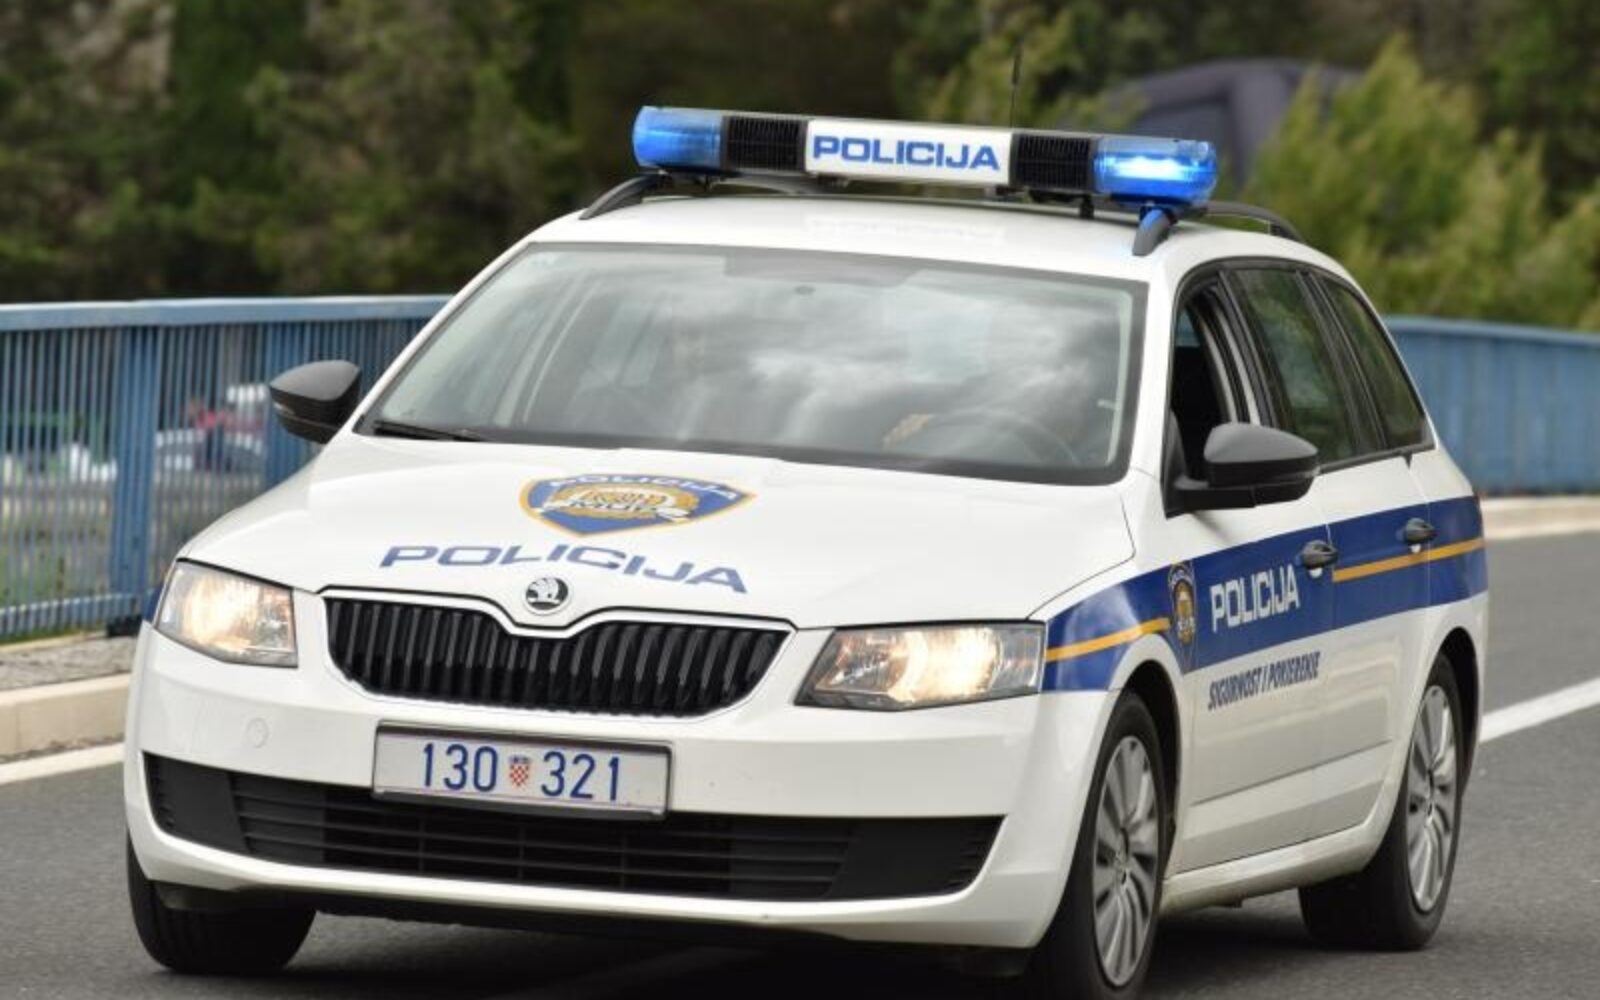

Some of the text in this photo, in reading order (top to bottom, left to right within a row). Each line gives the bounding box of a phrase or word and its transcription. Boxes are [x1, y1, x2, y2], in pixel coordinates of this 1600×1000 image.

[813, 135, 1000, 170] POLICIJA
[550, 475, 737, 500] POLICIJA
[379, 544, 747, 593] POLICIJA
[1210, 564, 1300, 632] POLICIJA
[422, 743, 619, 801] 130 321
